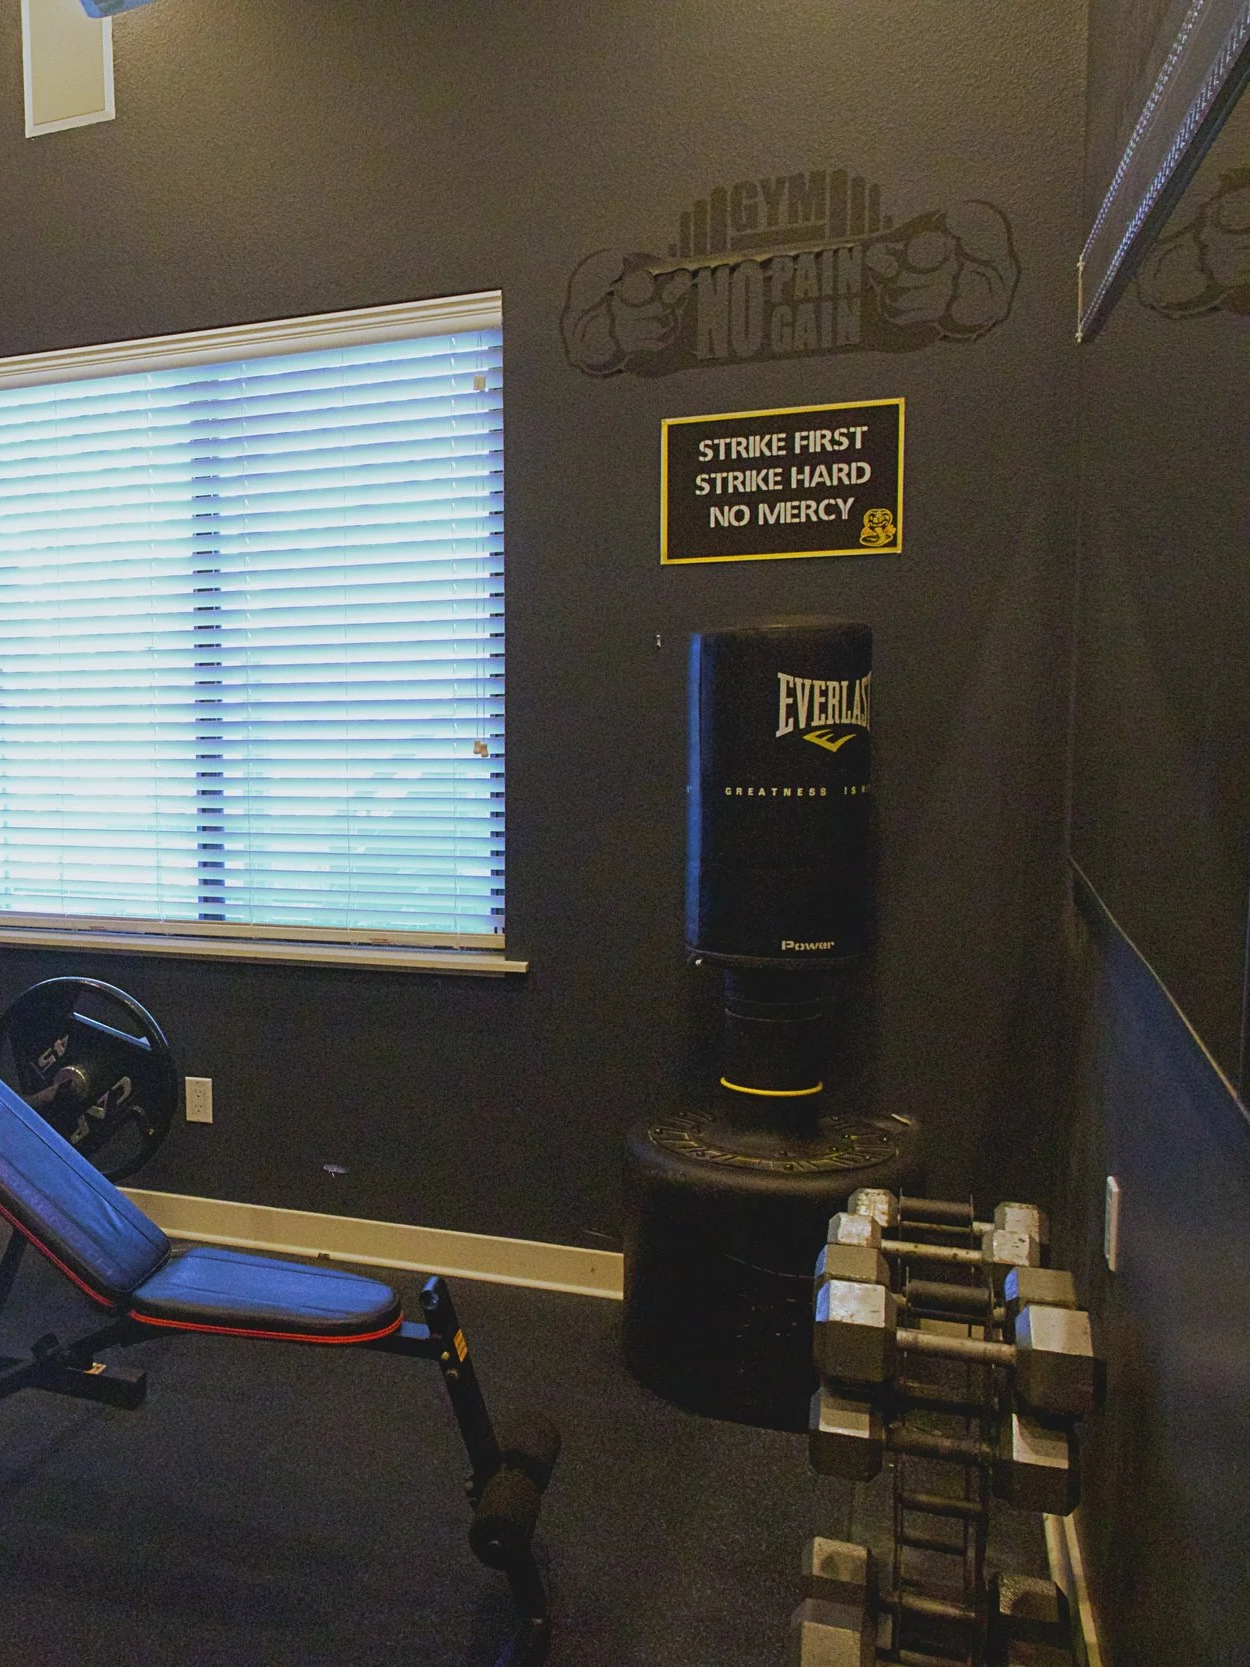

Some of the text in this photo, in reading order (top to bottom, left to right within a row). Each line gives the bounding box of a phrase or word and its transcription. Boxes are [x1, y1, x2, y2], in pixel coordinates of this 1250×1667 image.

[731, 170, 827, 232] GYM
[698, 246, 862, 359] NO PAIN
[771, 297, 861, 351] GAIN
[698, 426, 868, 462] STRIKE FIRST
[695, 461, 871, 495] STRIKE HARD
[710, 497, 855, 528] NO MERCY
[724, 787, 827, 796] GREATNESS
[843, 785, 857, 795] IS
[781, 940, 835, 951] Power
